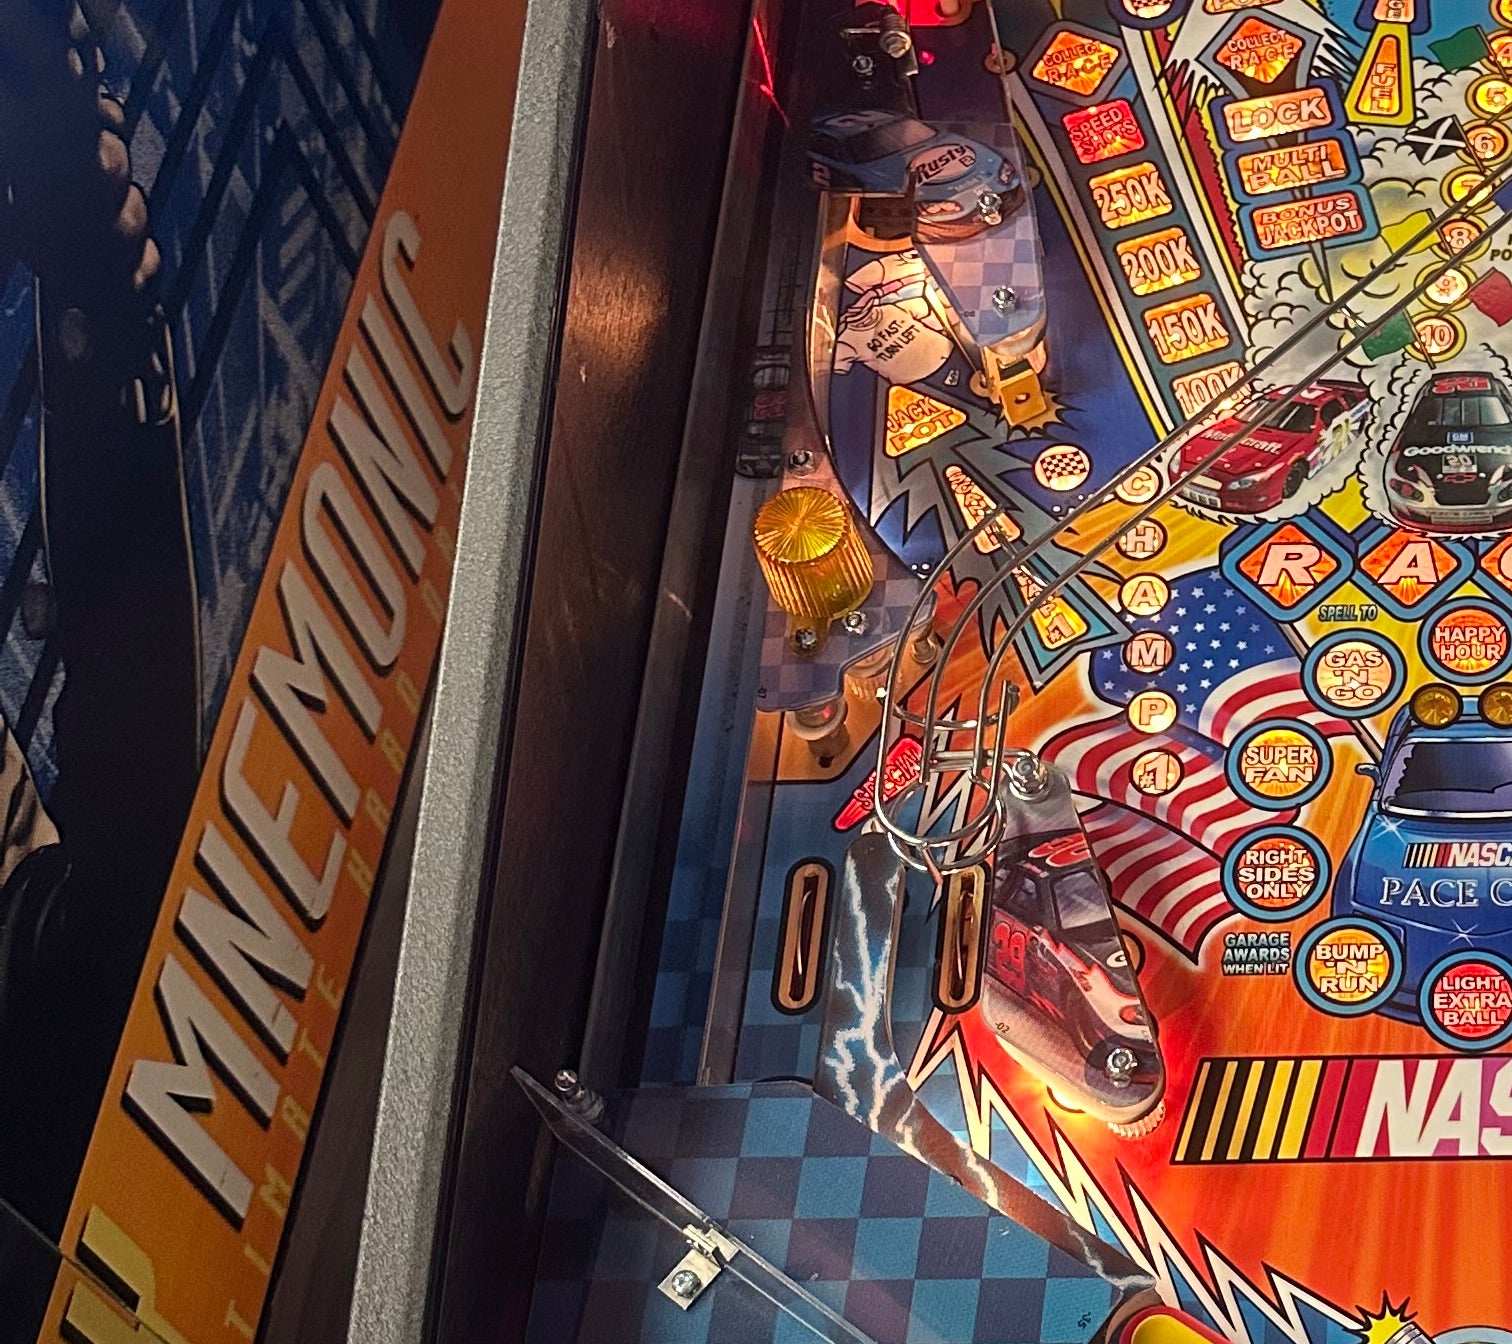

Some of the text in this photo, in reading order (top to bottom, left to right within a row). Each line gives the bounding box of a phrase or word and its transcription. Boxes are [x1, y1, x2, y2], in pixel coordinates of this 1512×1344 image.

[1231, 96, 1327, 134] LOCK
[1251, 145, 1329, 173] MULTI
[1248, 159, 1347, 191] BALL
[1092, 167, 1173, 219] 250K
[1261, 197, 1351, 225] BONUS
[1259, 212, 1360, 246] JACKPOT
[1318, 604, 1379, 622] SPELL TO
[1433, 625, 1507, 646] HAPPY
[1324, 649, 1384, 669] GAS
[1438, 643, 1503, 661] HOUR
[1325, 685, 1384, 702] GO
[122, 209, 474, 1227] MNEMONIC
[1245, 745, 1316, 766] SUPER
[1244, 765, 1315, 784] FAN
[1245, 848, 1308, 866] RIGHT
[1238, 865, 1316, 884] SIDES
[1245, 881, 1310, 900] ONLY
[1380, 876, 1480, 908] PACE
[1224, 931, 1291, 947] GARAGE
[1223, 946, 1291, 963] AWARDS
[1315, 943, 1386, 961] BUMP
[1223, 962, 1290, 975] WHEN LIT
[1320, 976, 1380, 995] RUN
[1442, 975, 1504, 992] LIGHT
[1442, 1009, 1506, 1027] BALL
